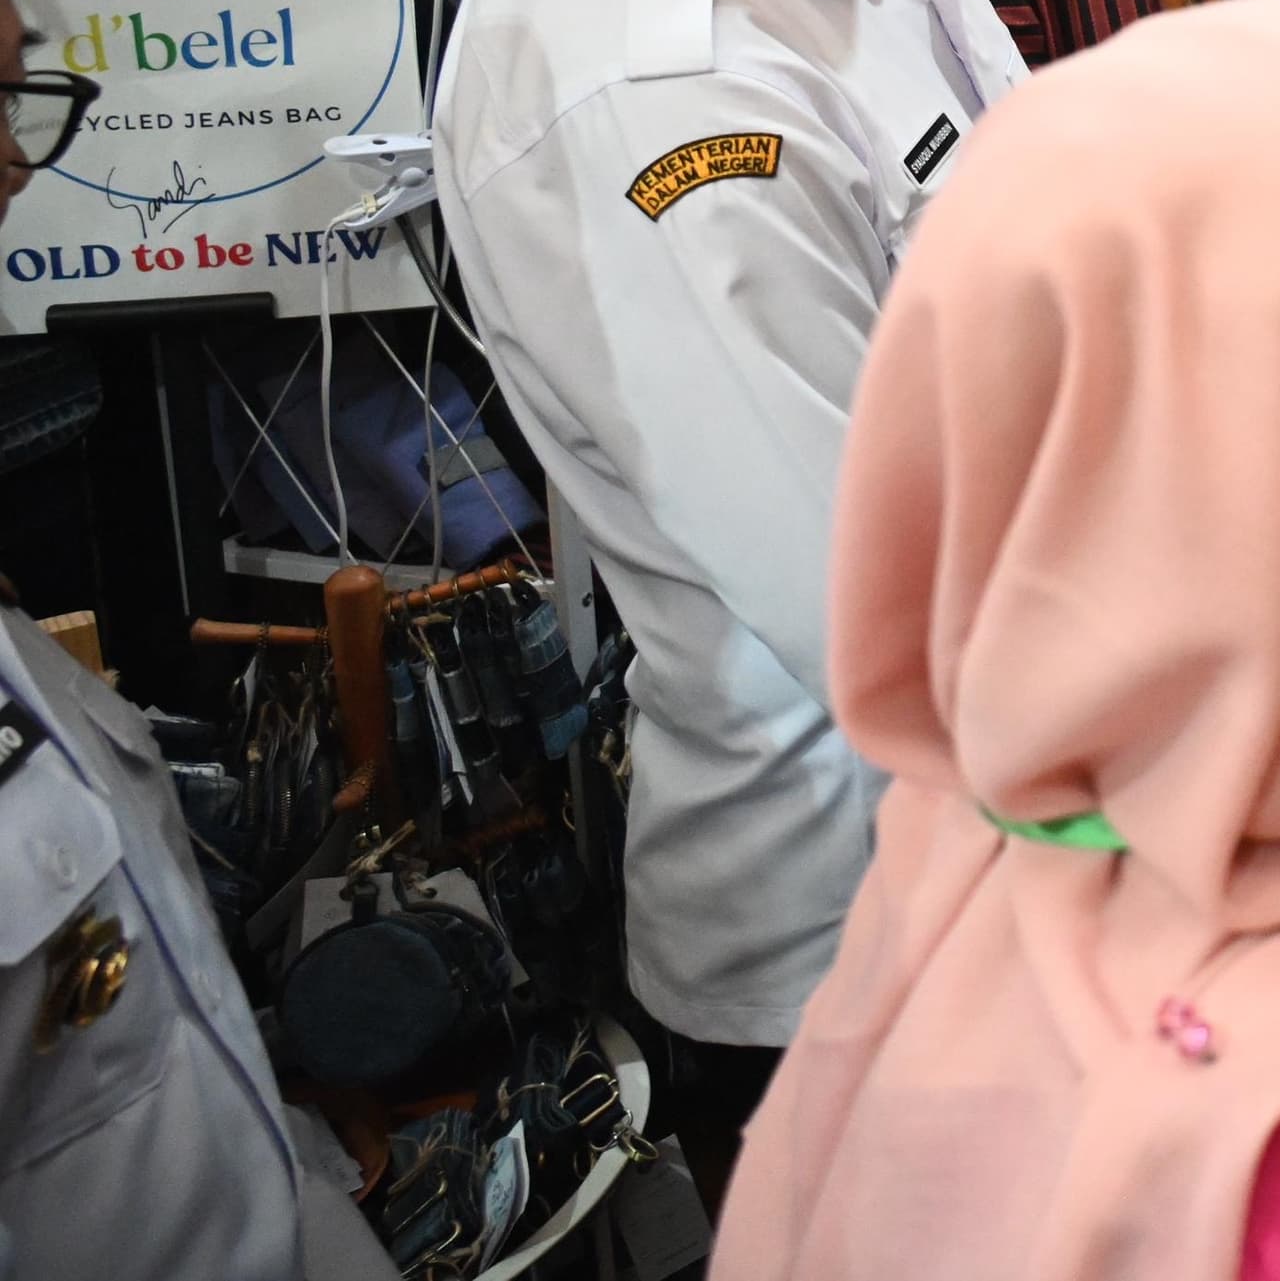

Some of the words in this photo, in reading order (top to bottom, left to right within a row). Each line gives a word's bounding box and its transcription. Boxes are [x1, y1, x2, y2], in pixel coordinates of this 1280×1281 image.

[184, 110, 274, 128] JEANS
[286, 106, 342, 123] BAG
[634, 138, 771, 199] KEMENTERIAN
[646, 167, 701, 210] DALAM
[706, 157, 769, 176] NEGERI
[7, 246, 120, 281] OLD
[132, 235, 185, 273] to
[197, 233, 254, 270] be
[265, 227, 387, 268] NEW
